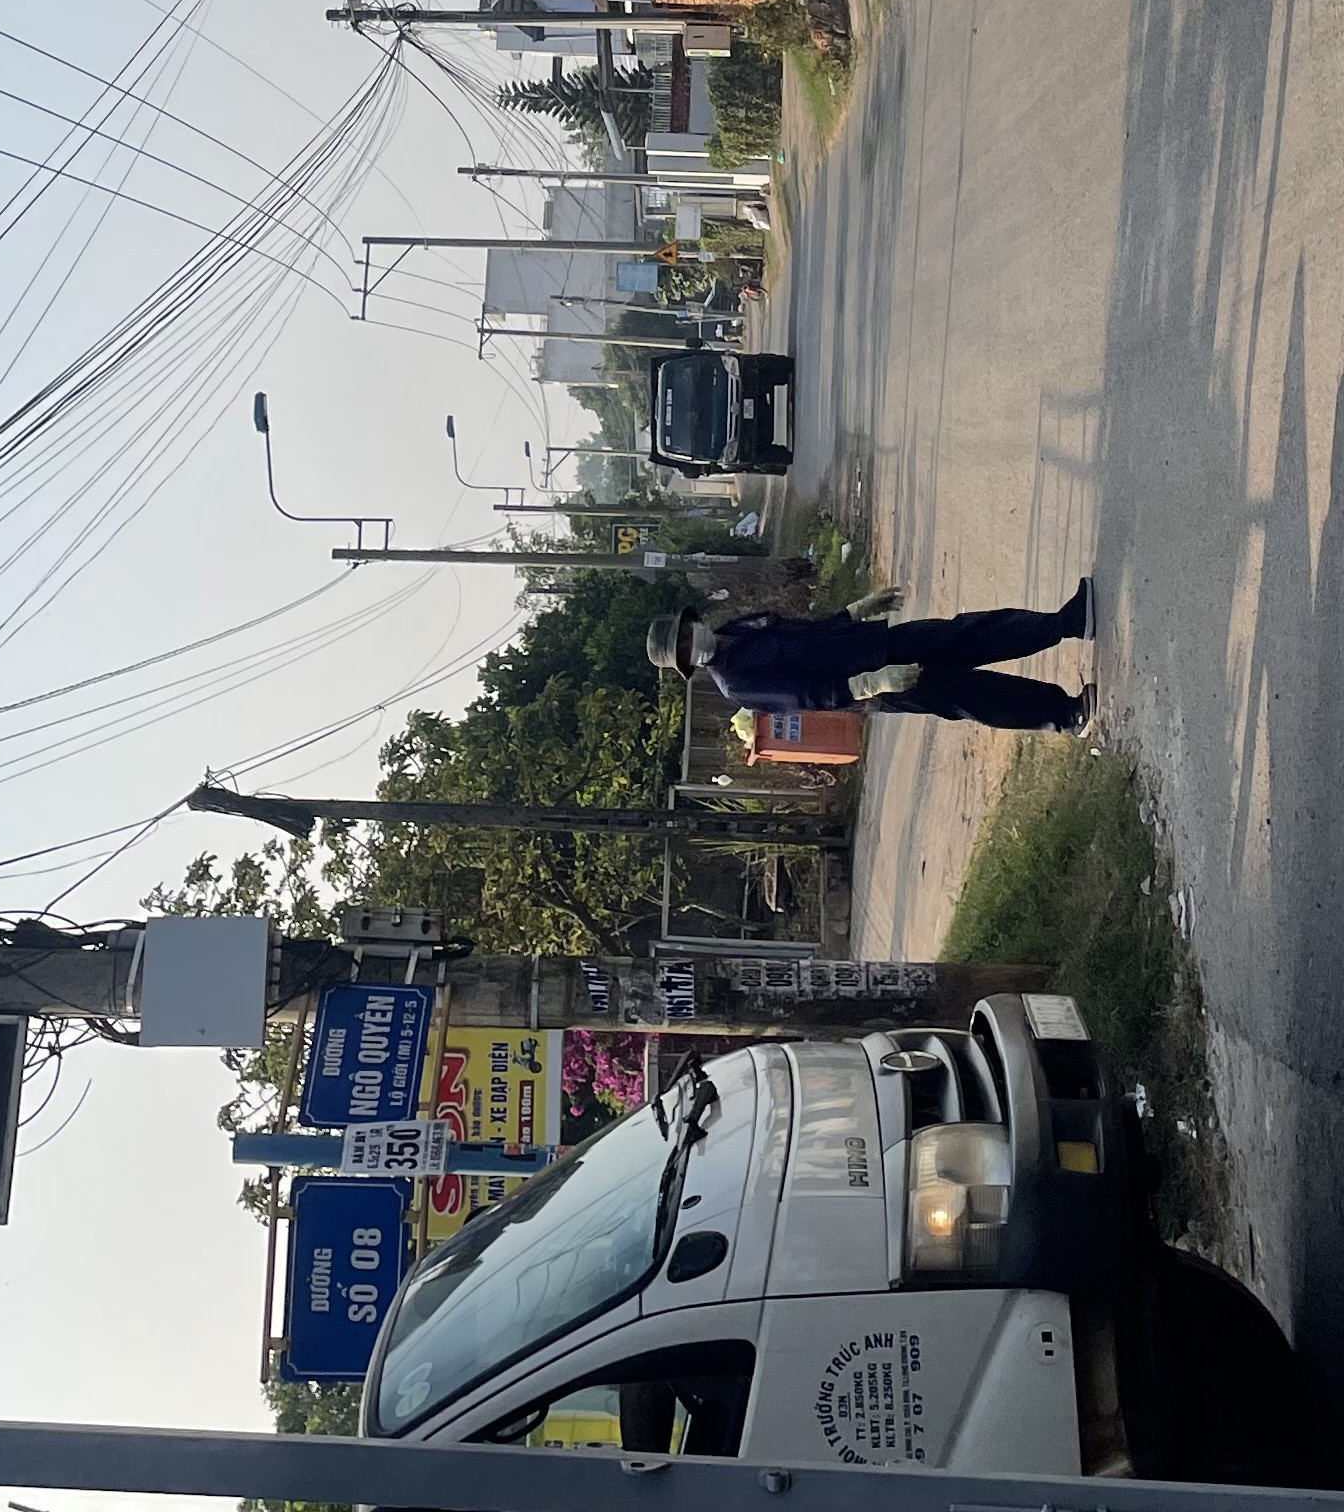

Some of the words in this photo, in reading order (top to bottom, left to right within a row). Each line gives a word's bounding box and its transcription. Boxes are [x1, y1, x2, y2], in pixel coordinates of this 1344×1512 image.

[354, 995, 396, 1064] QUYỀN
[396, 1040, 413, 1060] (M)
[320, 1028, 347, 1076] ĐƯỜNG
[348, 1070, 384, 1116] NGÔ
[388, 1091, 408, 1106] LỘ
[490, 1107, 507, 1123] XE
[384, 1129, 422, 1169] 350
[844, 1137, 869, 1187] HINO
[350, 1228, 382, 1270] 08
[305, 1248, 333, 1312] ĐƯỜNG
[337, 1282, 379, 1323] SỐ
[825, 1341, 861, 1377] TRÚC
[864, 1332, 894, 1351] ANH
[909, 1334, 921, 1372] 909
[813, 1381, 842, 1447] TRƯỜNG
